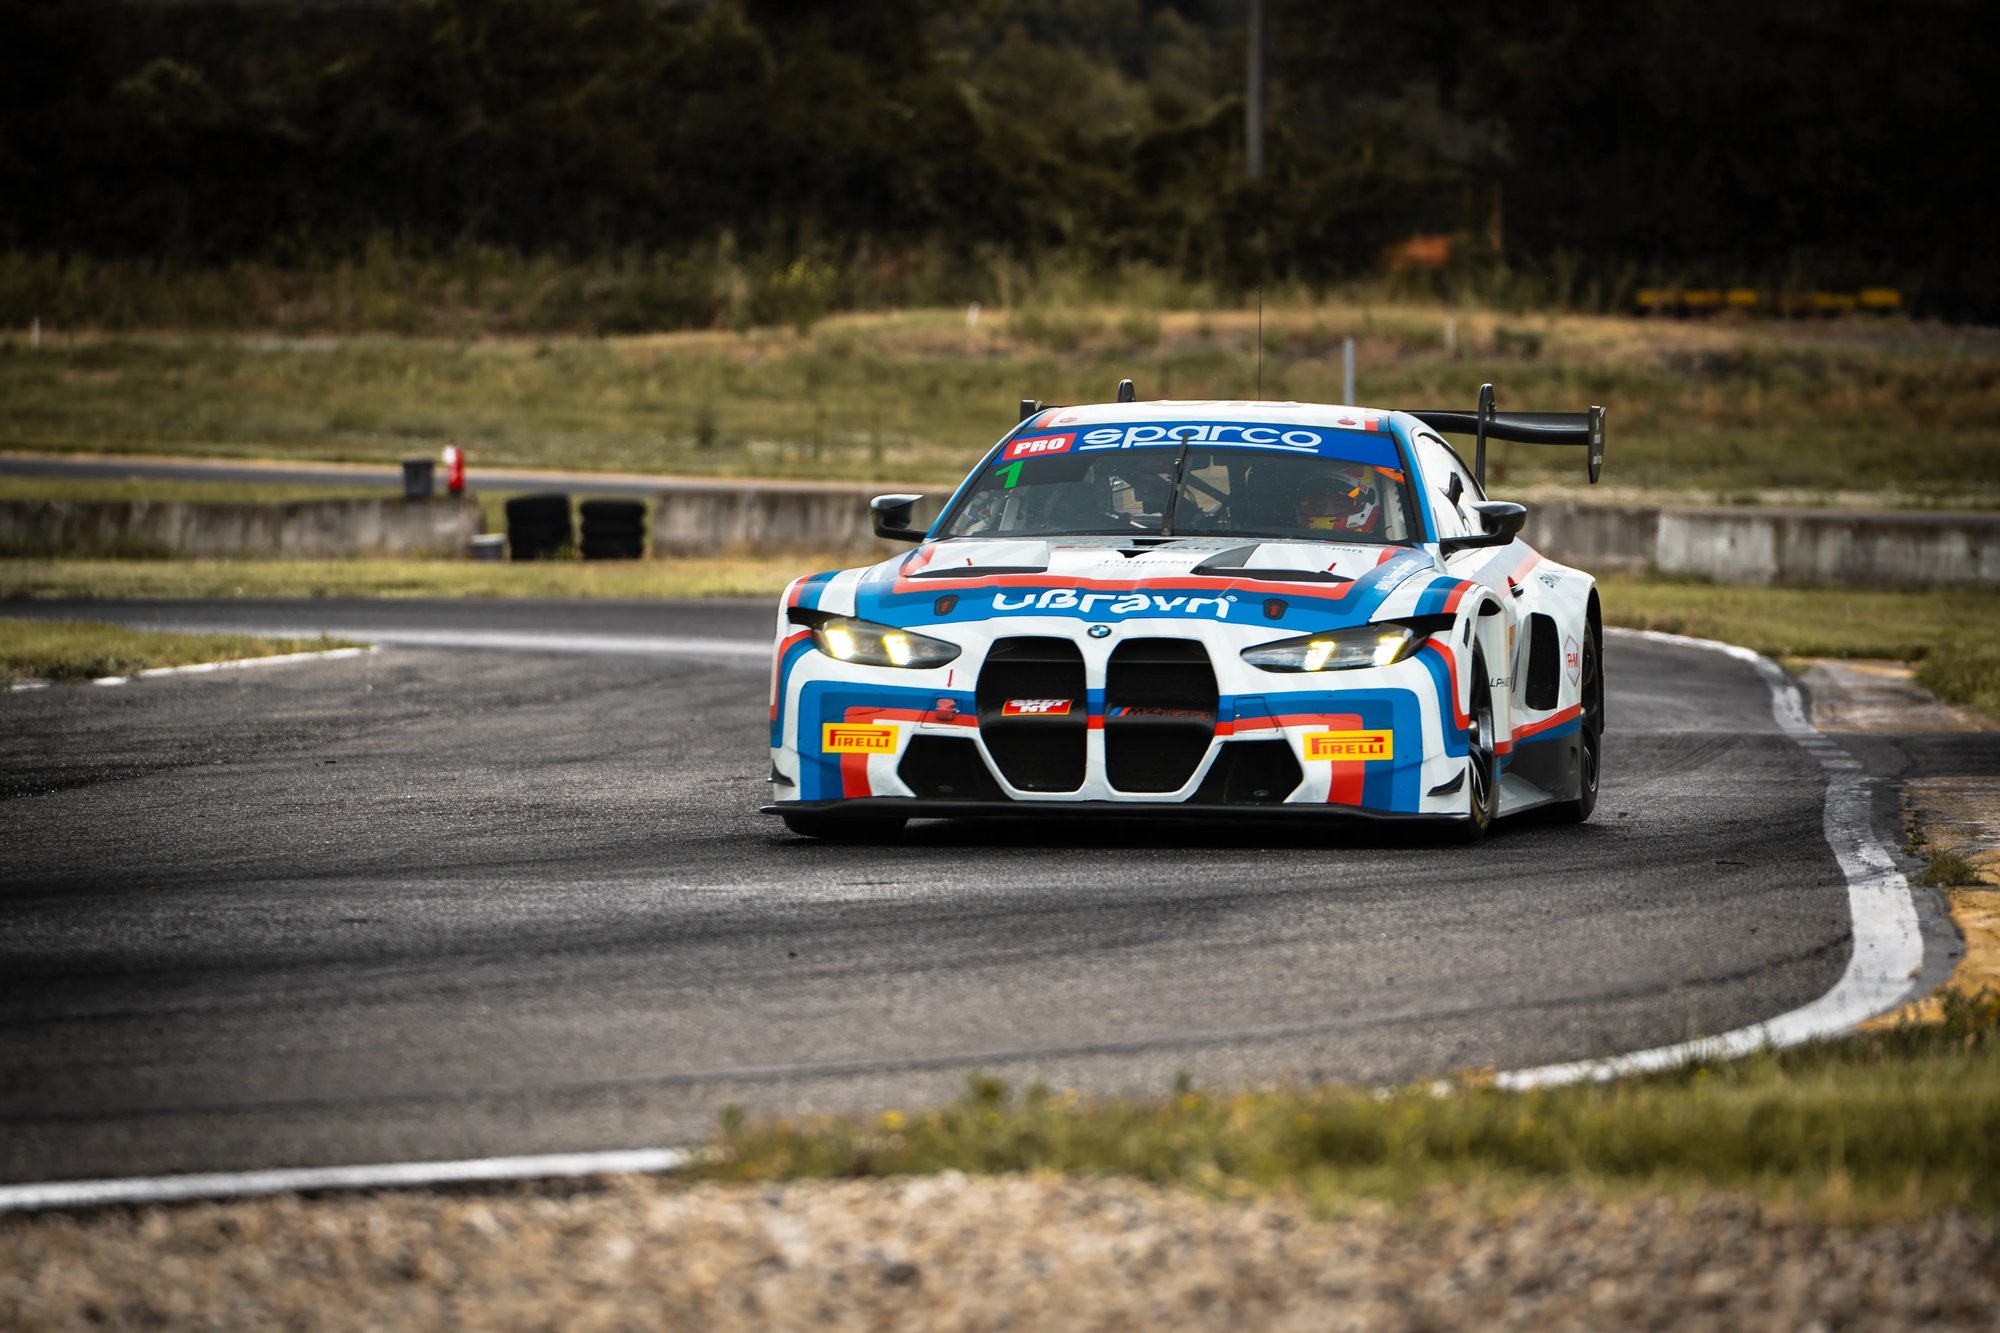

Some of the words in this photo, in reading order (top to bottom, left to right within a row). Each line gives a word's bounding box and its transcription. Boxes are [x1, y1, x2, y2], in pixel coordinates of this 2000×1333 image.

[1013, 437, 1066, 455] PRO
[1082, 425, 1322, 449] sparco
[994, 460, 1024, 489] 1
[829, 729, 891, 747] PIRELLI
[1311, 736, 1385, 754] PIRELLI
